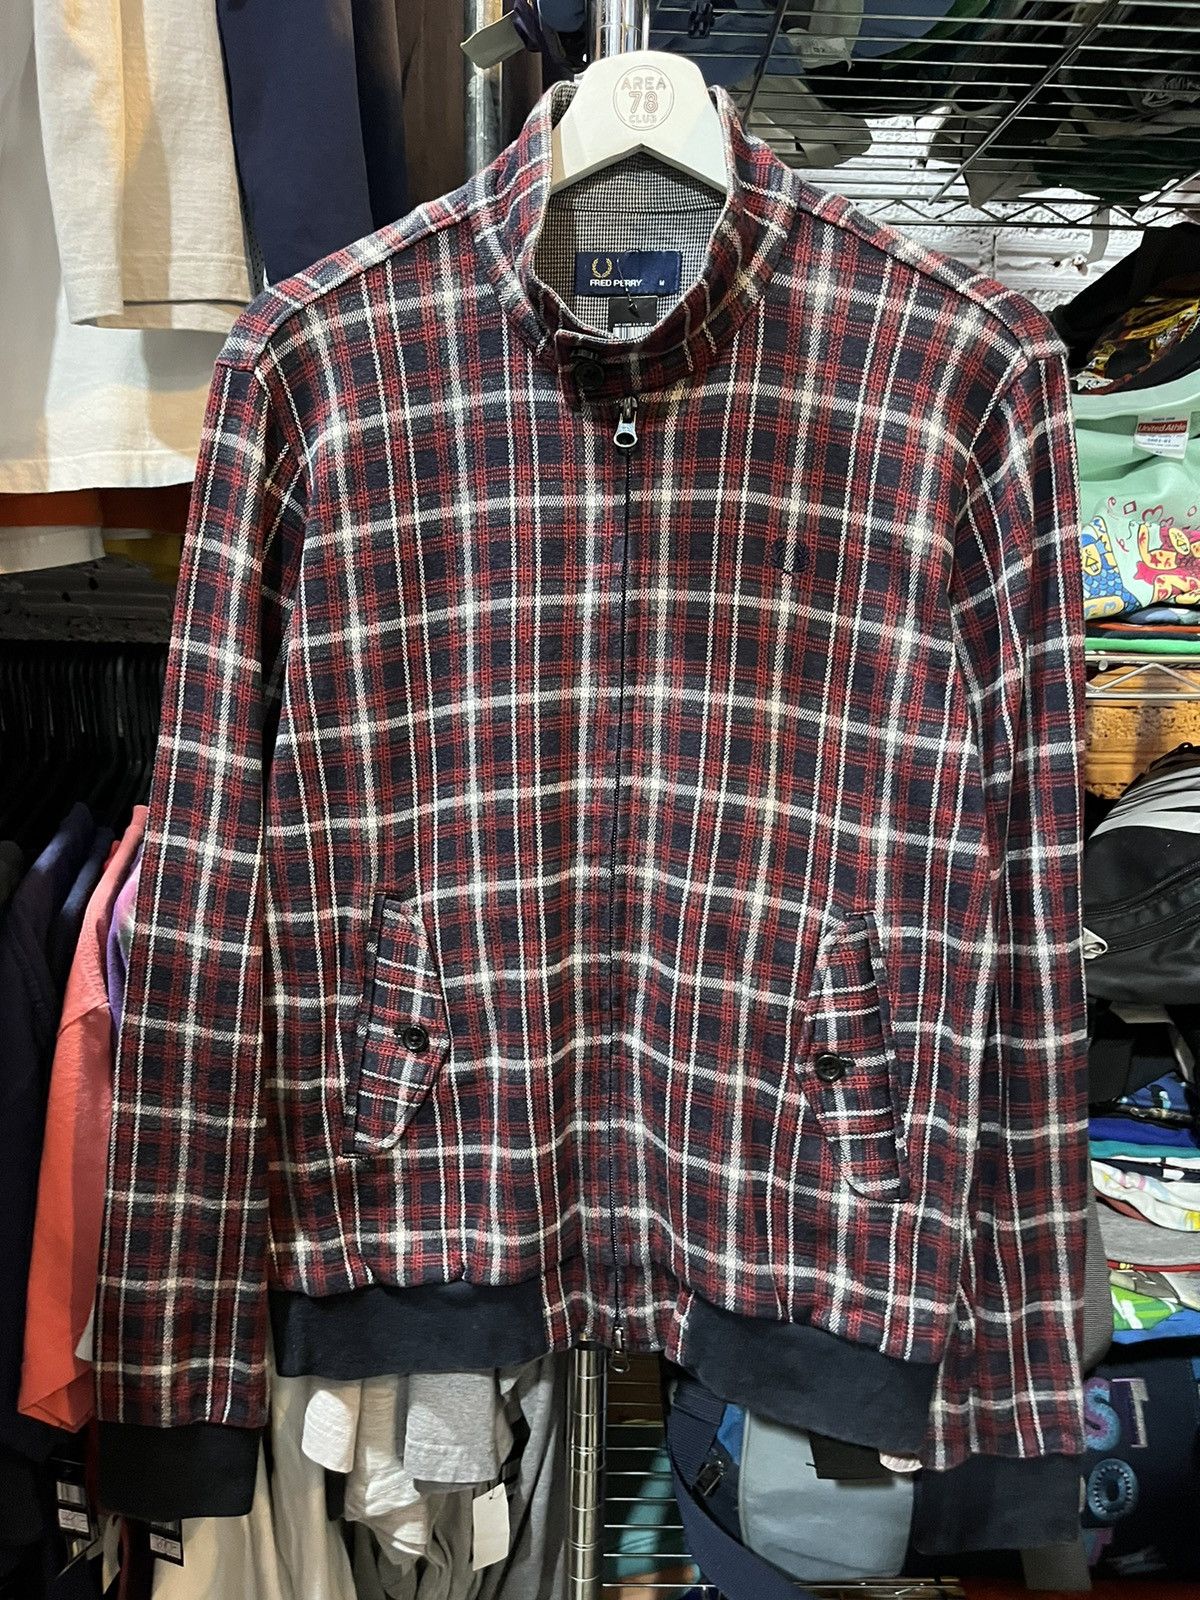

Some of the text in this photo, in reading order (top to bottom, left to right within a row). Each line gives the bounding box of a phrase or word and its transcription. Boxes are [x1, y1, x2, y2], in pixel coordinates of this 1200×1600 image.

[620, 76, 667, 91] AREA
[628, 91, 659, 114] 78
[628, 114, 657, 124] CLUB
[589, 279, 643, 287] FRED PERRY
